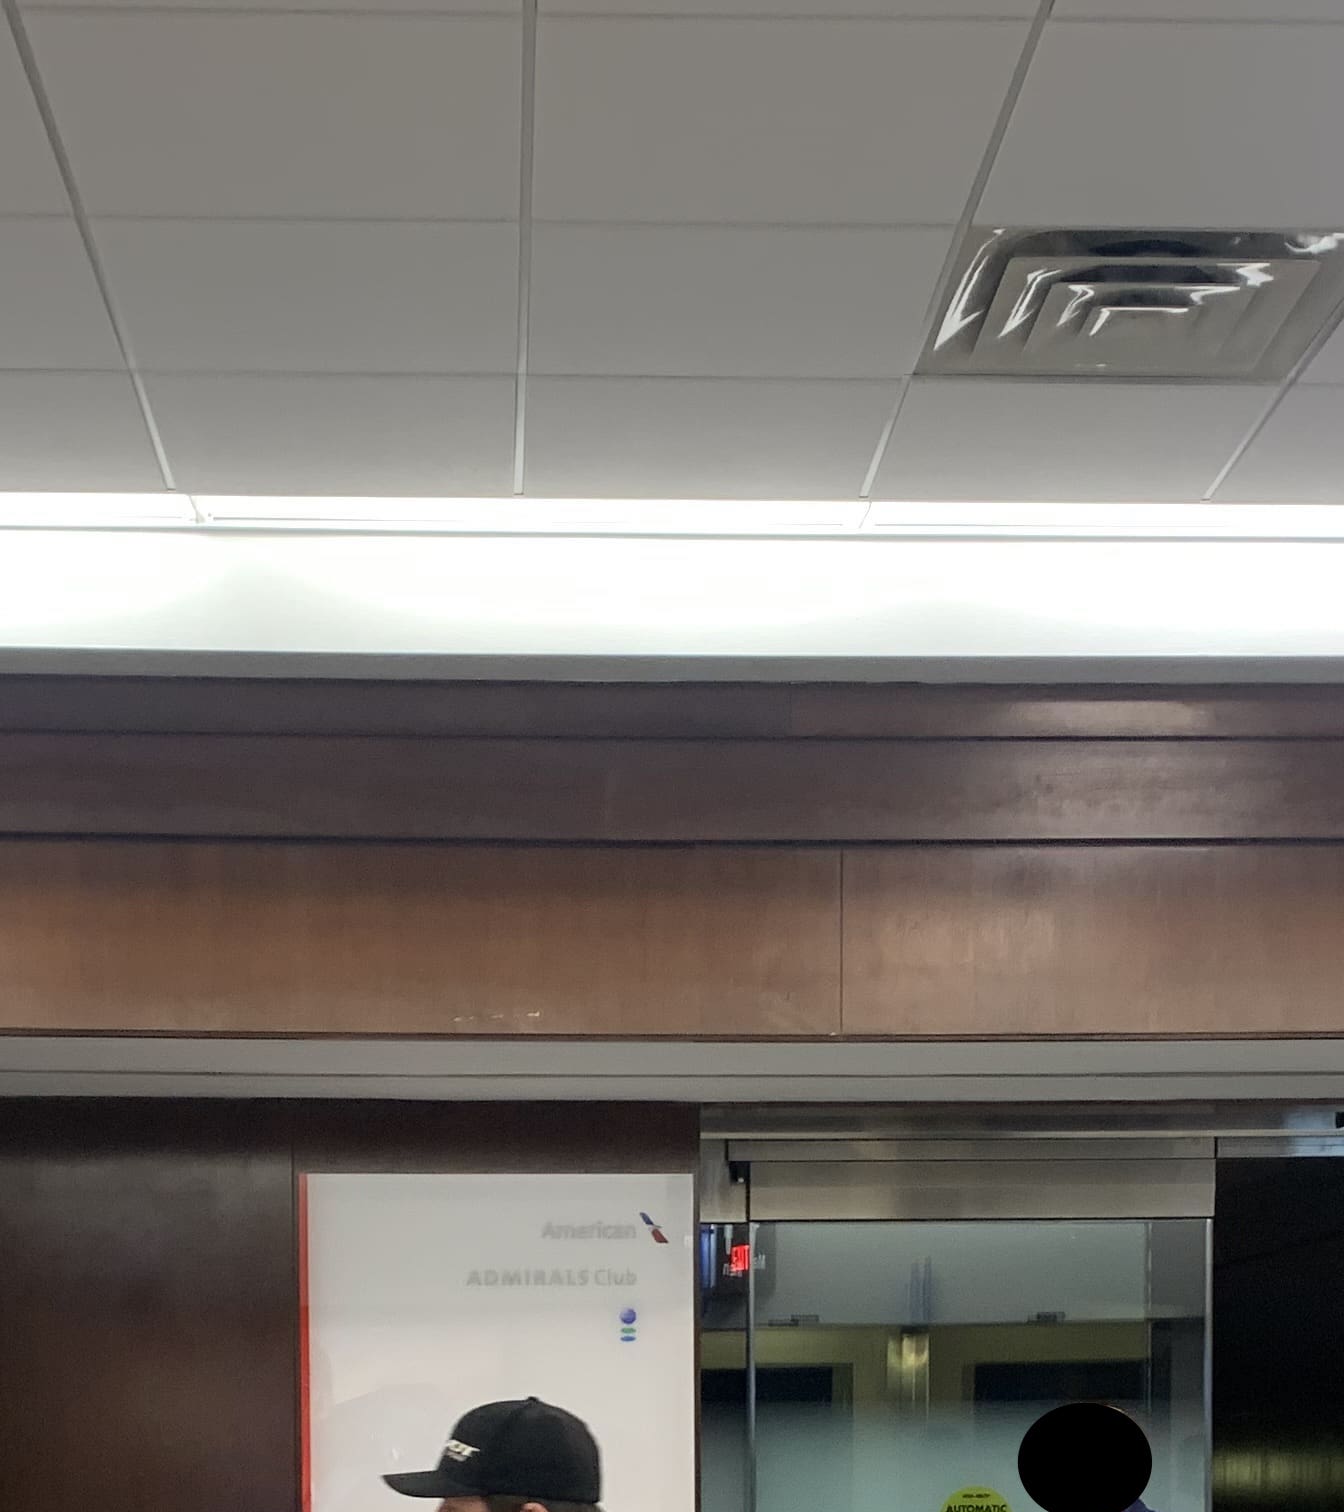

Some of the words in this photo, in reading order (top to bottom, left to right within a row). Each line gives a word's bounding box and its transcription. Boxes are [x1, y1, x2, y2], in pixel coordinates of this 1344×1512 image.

[541, 1220, 638, 1239] American
[466, 1270, 589, 1286] ADMIRALS
[594, 1267, 638, 1286] Club
